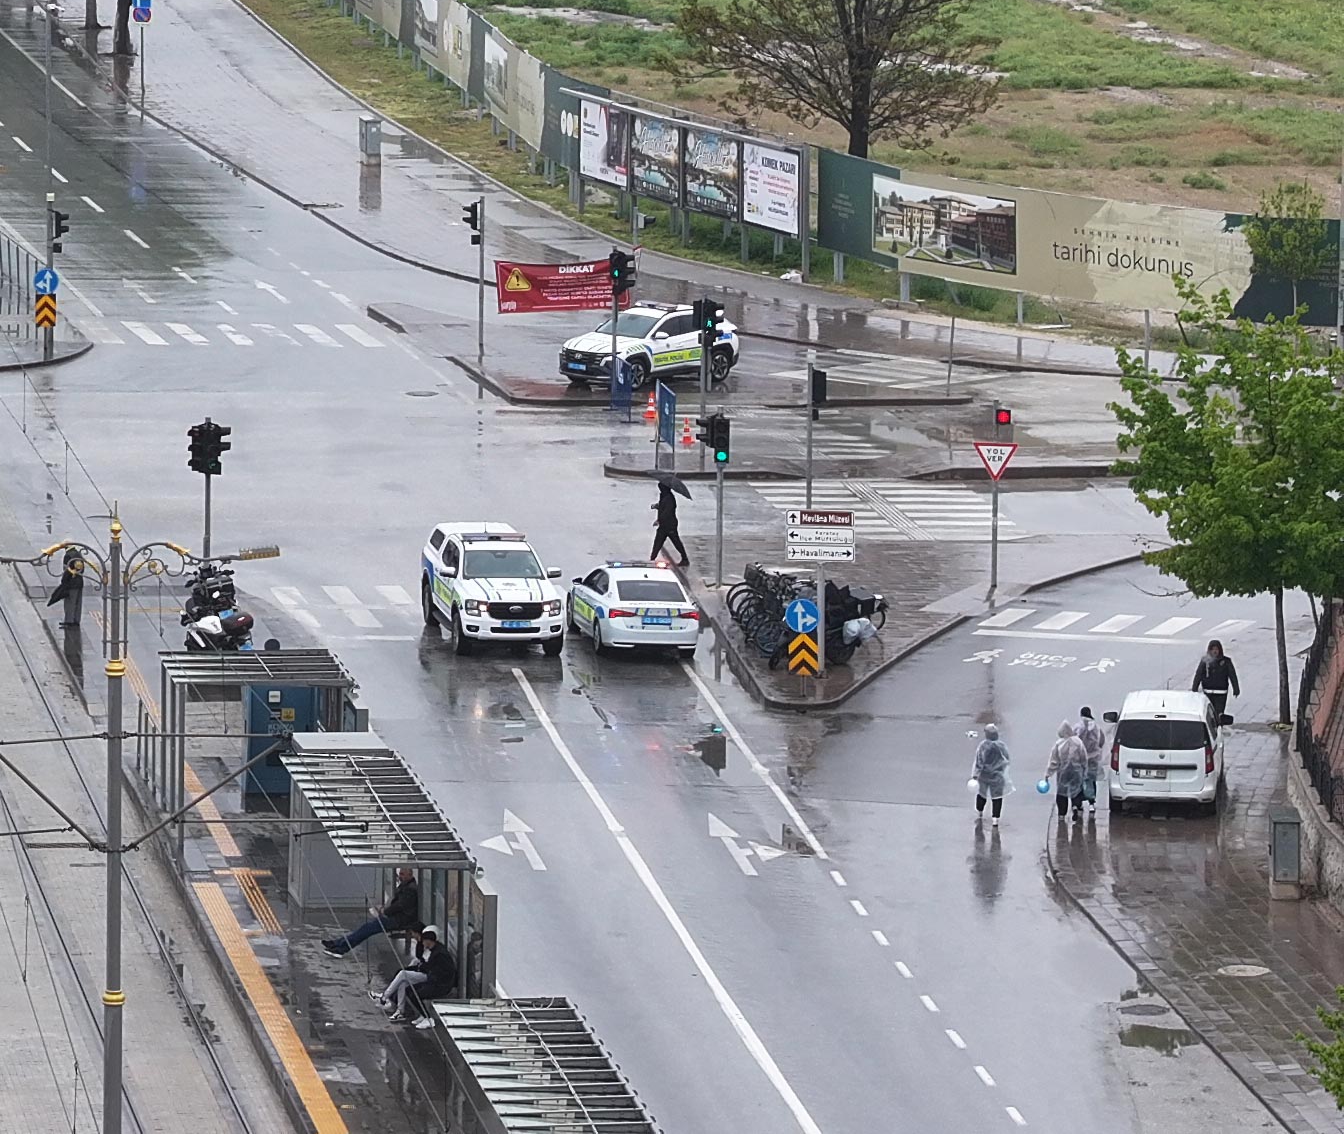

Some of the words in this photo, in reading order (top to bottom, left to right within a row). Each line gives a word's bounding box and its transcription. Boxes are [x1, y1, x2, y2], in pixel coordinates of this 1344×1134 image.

[1052, 242, 1101, 265] tarihi
[1106, 248, 1194, 278] dokunuş
[558, 264, 595, 274] DİKKAT
[828, 514, 850, 524] Müzesi
[1020, 651, 1077, 662] önce
[1008, 658, 1068, 668] yaya
